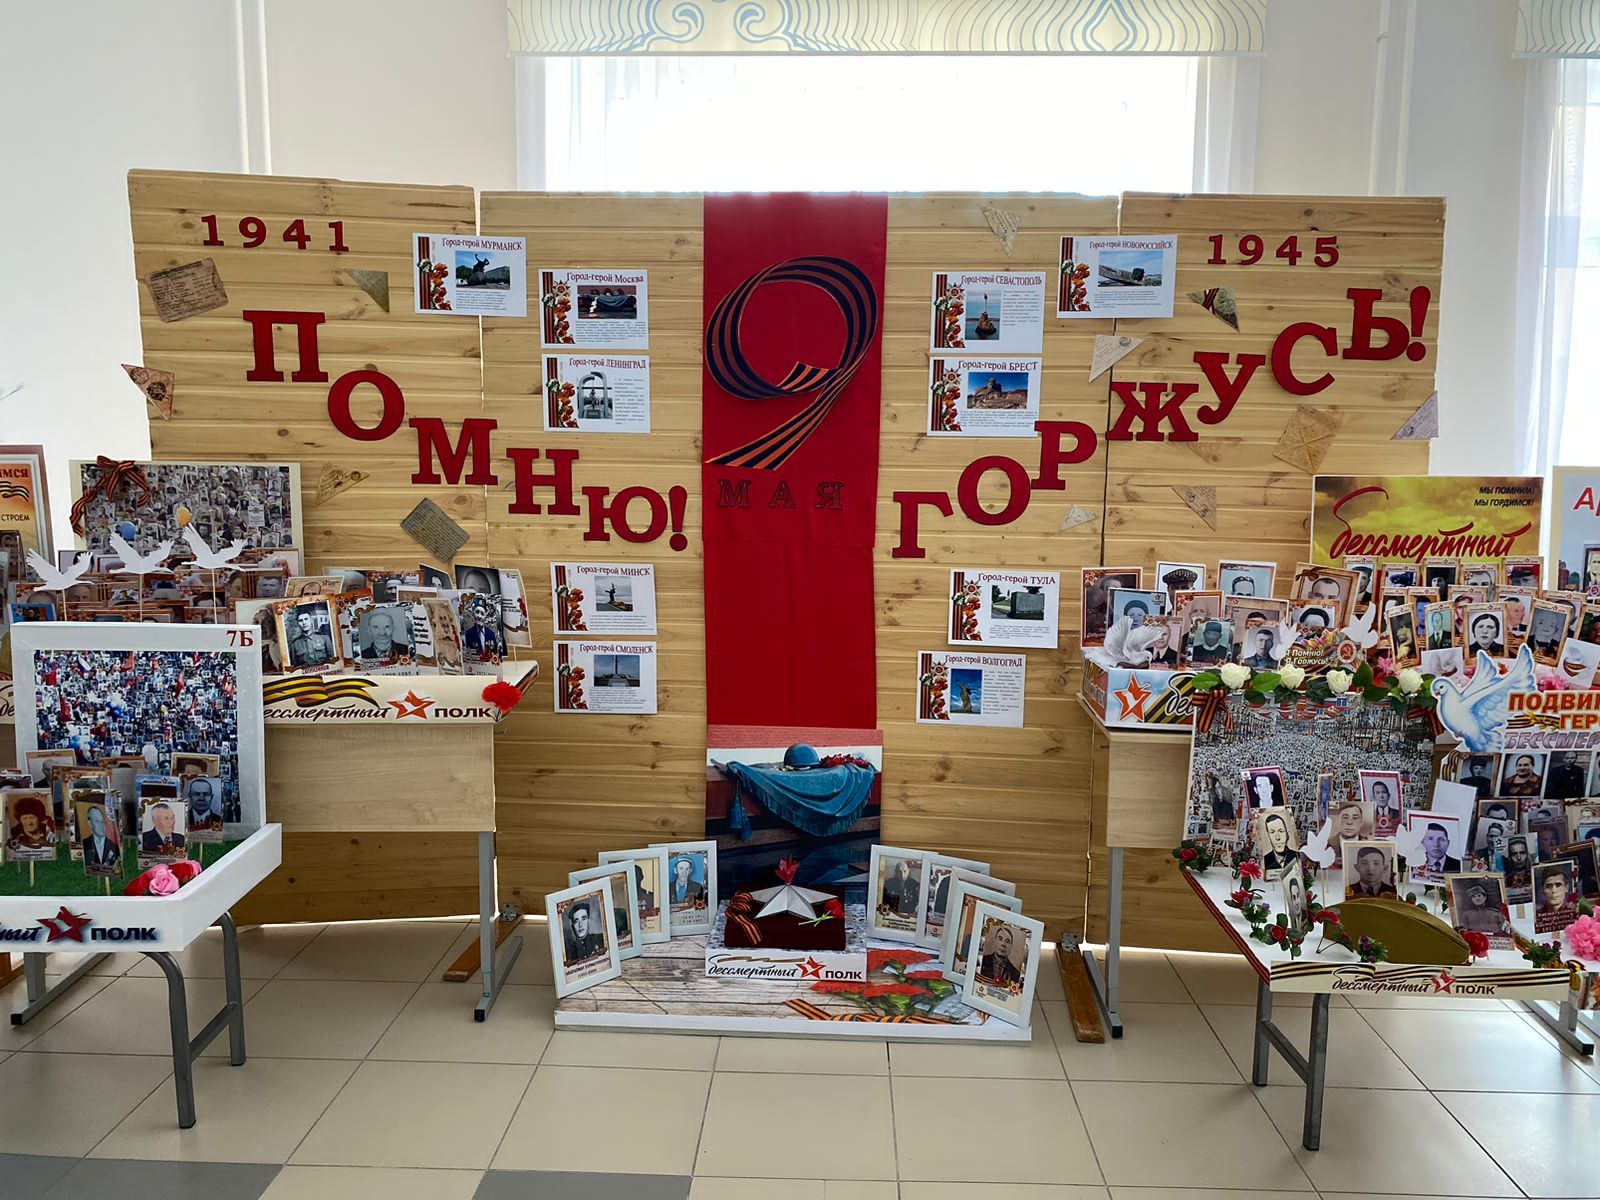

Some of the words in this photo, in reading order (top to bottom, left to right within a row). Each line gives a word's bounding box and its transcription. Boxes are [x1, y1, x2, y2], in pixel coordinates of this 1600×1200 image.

[200, 214, 350, 252] 1941
[442, 237, 480, 249] Город-герой
[481, 240, 522, 251] МУРМАНСК
[1089, 240, 1121, 250] Город-герой
[1207, 233, 1340, 268] 1945
[566, 271, 613, 283] Город-герой
[614, 274, 645, 283] Москва
[961, 275, 995, 286] Город-герой
[995, 275, 1042, 287] СЕВАСТОПОЛЬ
[569, 357, 604, 369] Город-герой
[605, 359, 646, 369] ЛЕНИНГРАД
[958, 359, 1007, 372] Город-герой
[1009, 361, 1038, 371] БРЕСТ
[892, 285, 1431, 559] ГОРЖУСЬ!
[243, 309, 688, 552] ПОМНЮ!
[0, 468, 29, 478] МСЯ
[1573, 487, 1600, 516] А
[1, 514, 30, 522] СТРОЕМ
[577, 565, 619, 577] Город-герой
[620, 567, 650, 576] МИНСК
[978, 572, 1028, 584] Город-герой
[1030, 575, 1056, 585] ТУЛА
[226, 629, 254, 648] 7Б
[580, 643, 614, 654] Город-герой
[615, 645, 653, 655] СМОЛЕНСК
[945, 654, 982, 665] Город-герой
[982, 656, 1023, 667] ВОЛГОГРАД
